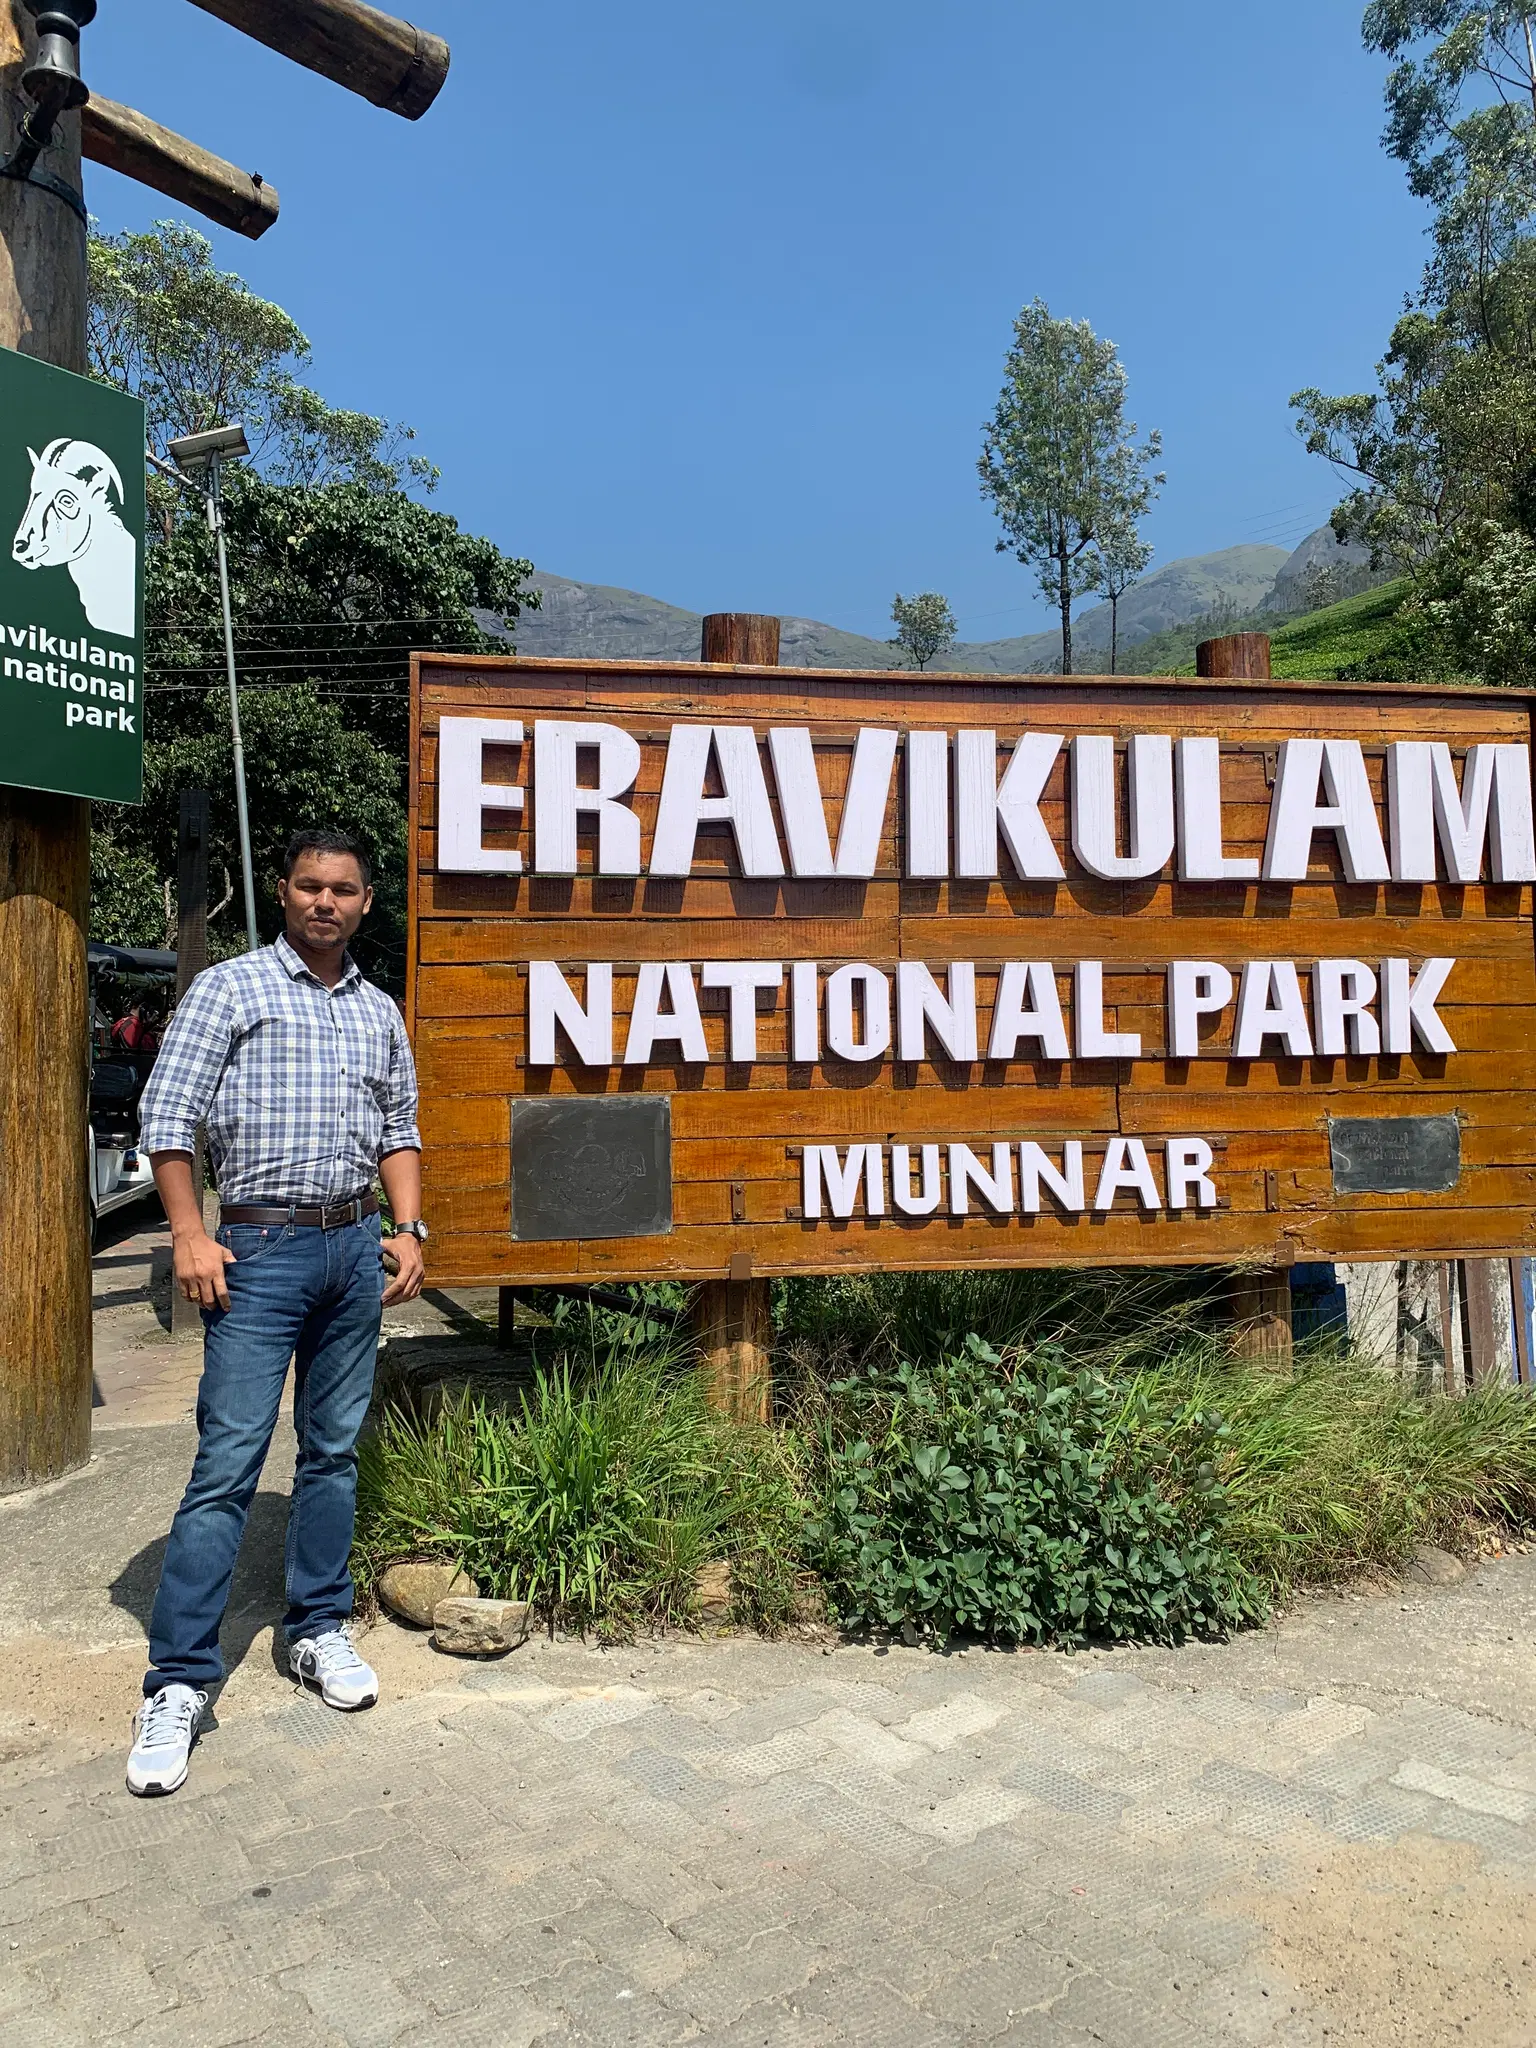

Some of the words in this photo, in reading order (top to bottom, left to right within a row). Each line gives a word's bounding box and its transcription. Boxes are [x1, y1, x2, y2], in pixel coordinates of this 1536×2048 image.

[4, 656, 135, 704] national
[66, 701, 136, 734] park
[438, 715, 1536, 884] ERAVIKULAM
[527, 960, 1142, 1066] NATIONAL
[1168, 957, 1458, 1059] PARK
[803, 1137, 1218, 1219] MUNNAR
